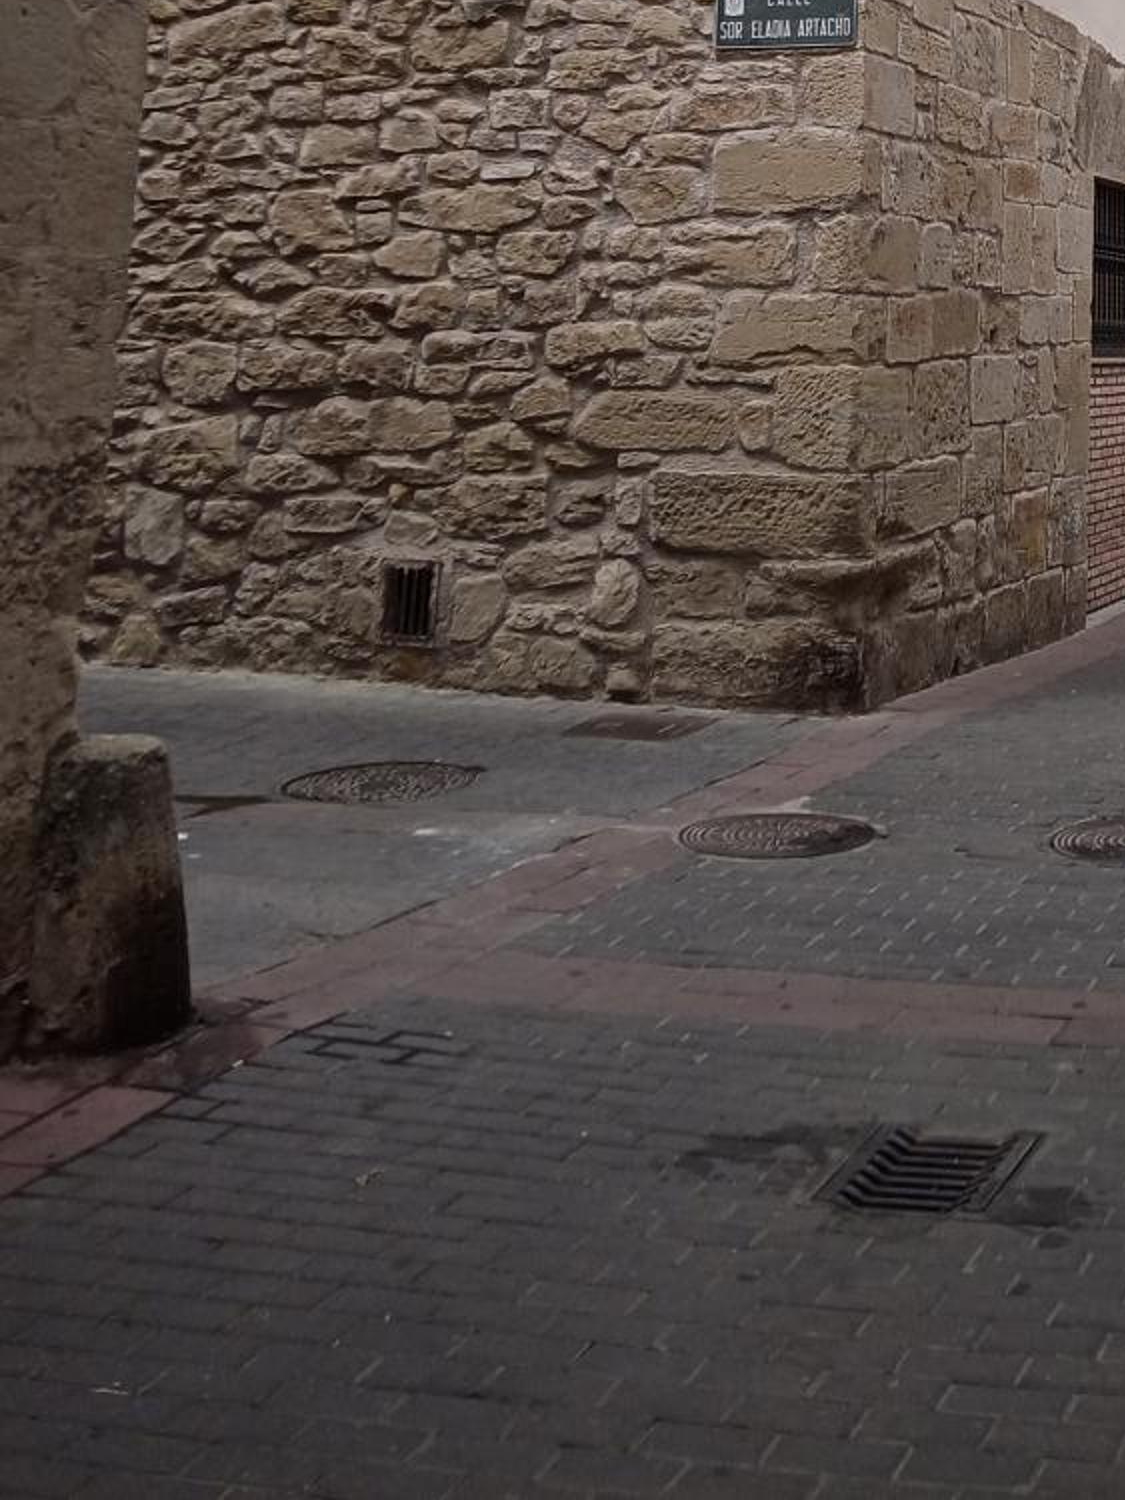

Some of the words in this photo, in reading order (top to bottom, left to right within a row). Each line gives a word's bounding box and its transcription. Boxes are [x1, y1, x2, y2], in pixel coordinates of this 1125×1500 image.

[719, 21, 743, 40] SOR
[751, 19, 791, 38] ELADIA
[797, 17, 851, 37] ARTACHO
